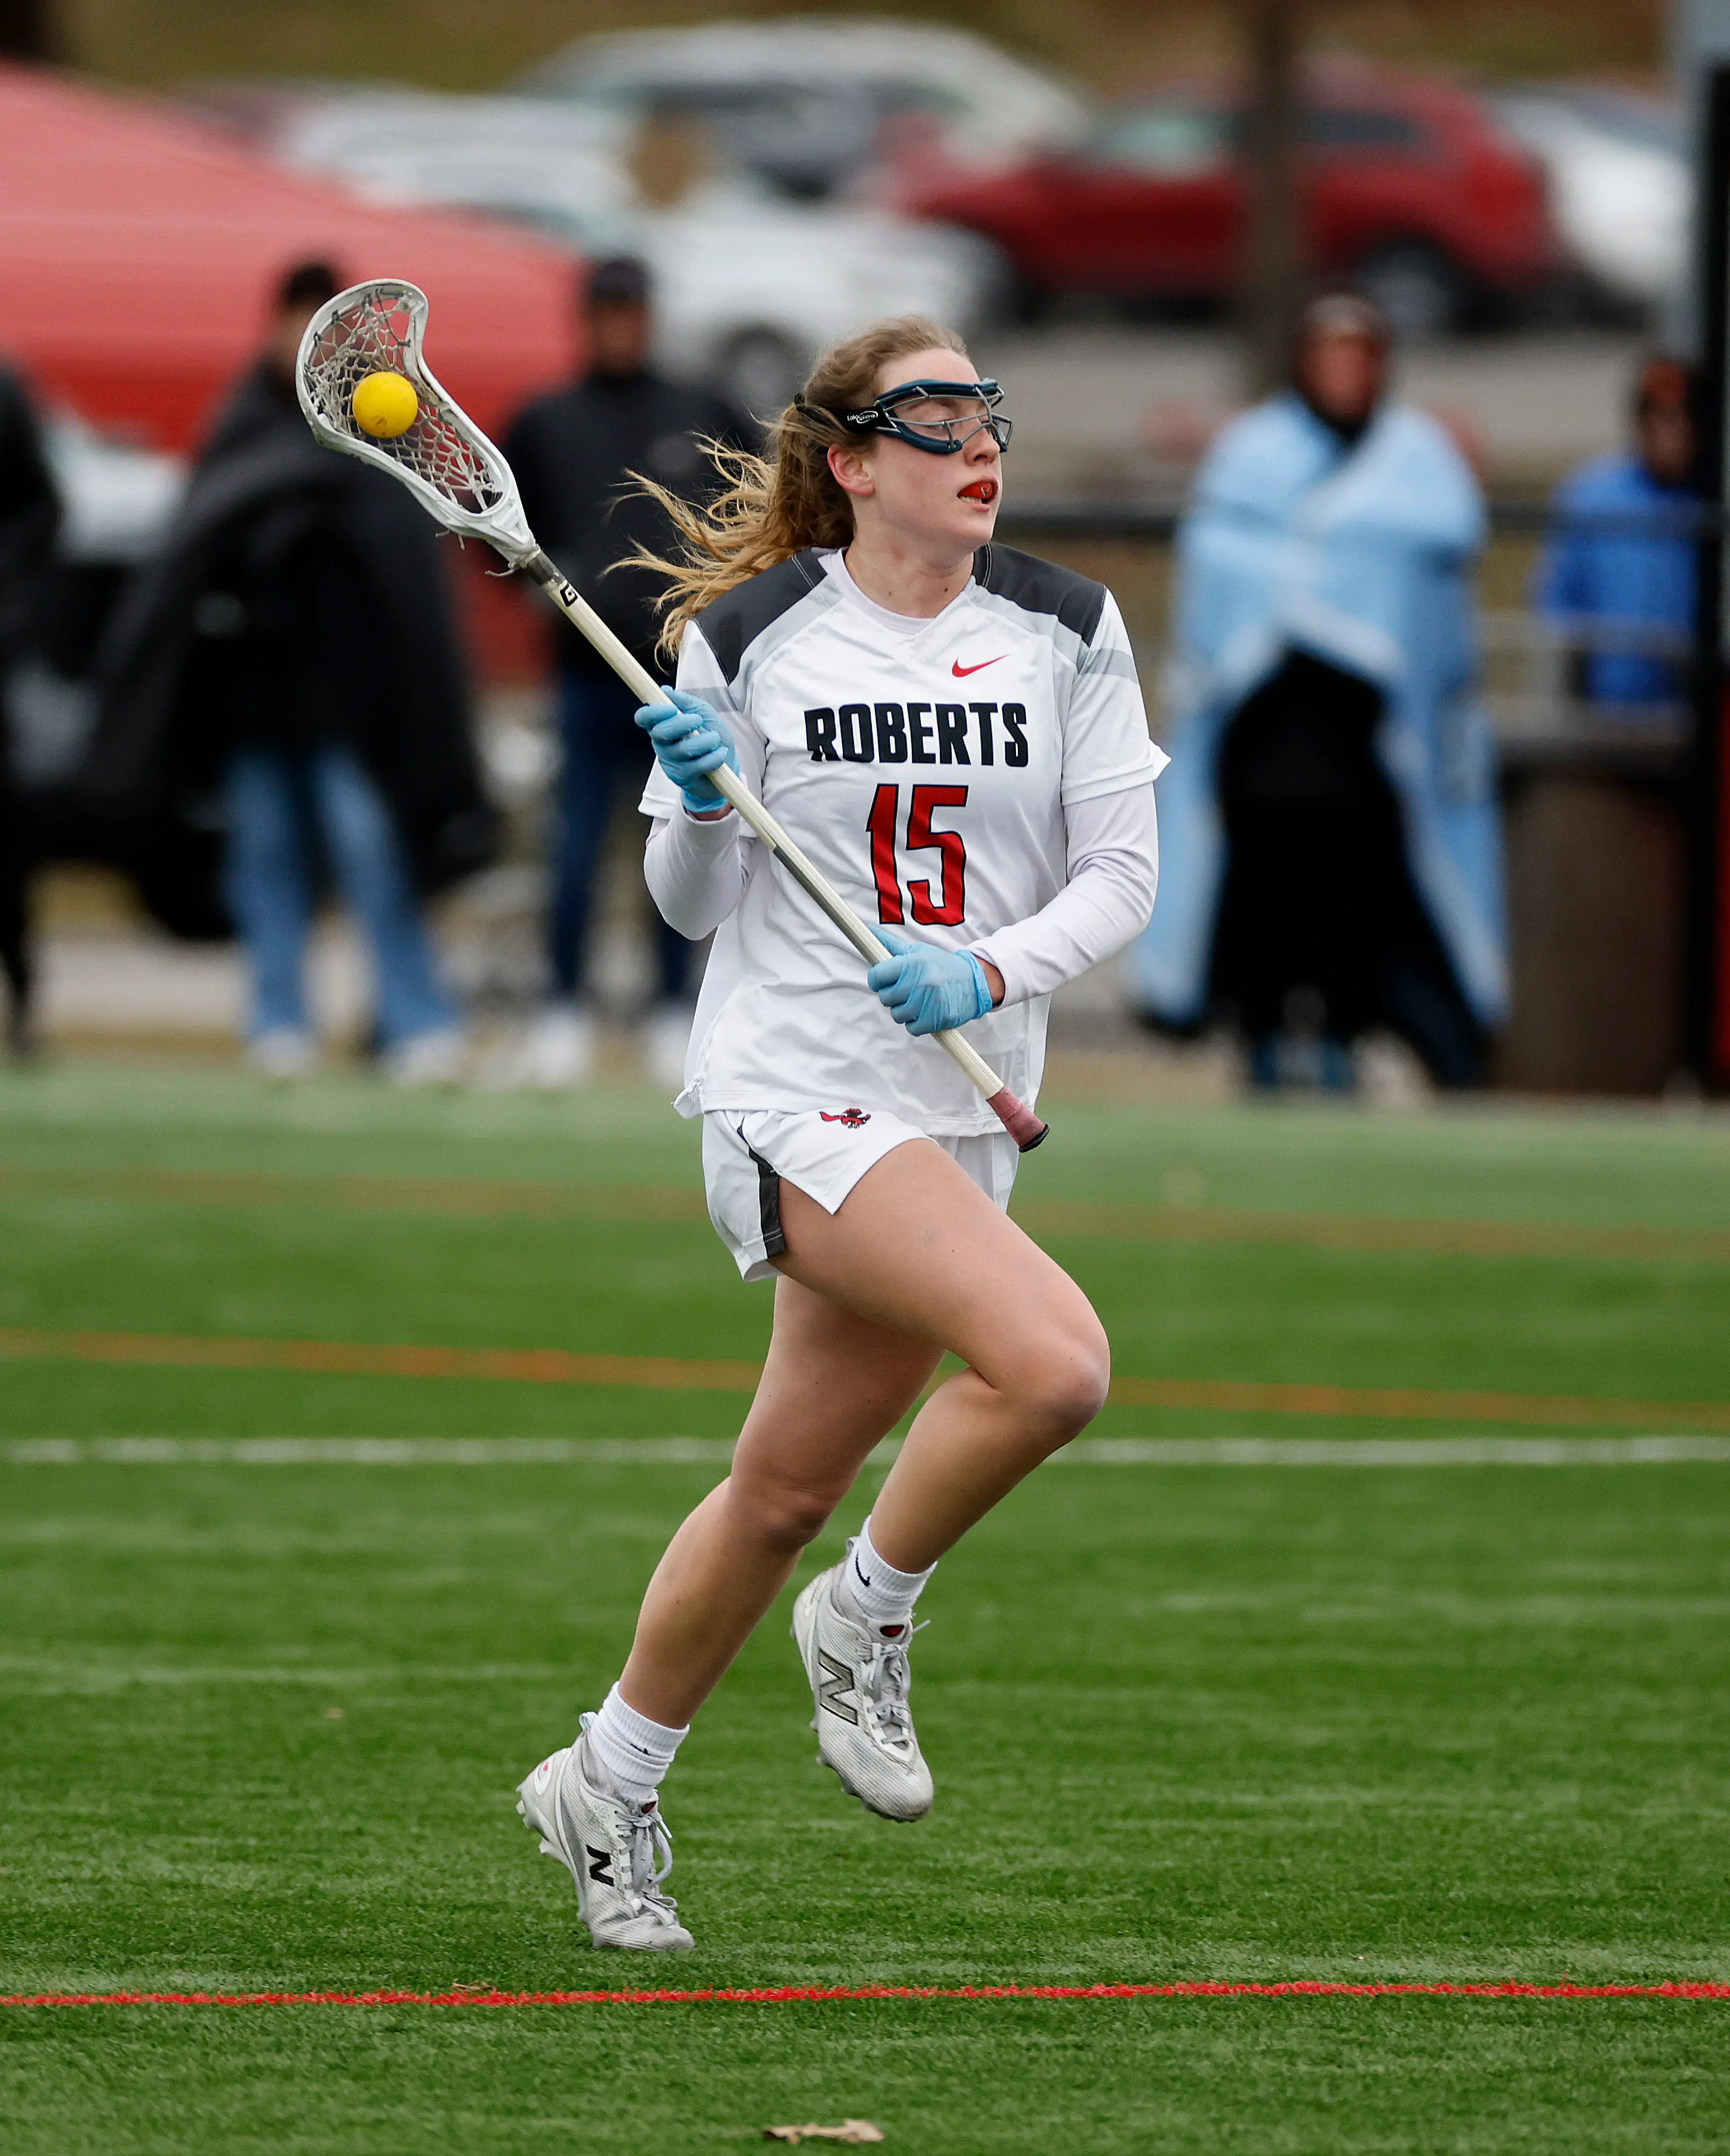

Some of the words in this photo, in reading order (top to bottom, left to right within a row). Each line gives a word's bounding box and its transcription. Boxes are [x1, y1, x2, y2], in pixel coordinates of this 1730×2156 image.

[804, 702, 1028, 768] ROBERTS
[866, 783, 969, 927] 15
[819, 1647, 858, 1726] N
[585, 1844, 615, 1887] N
